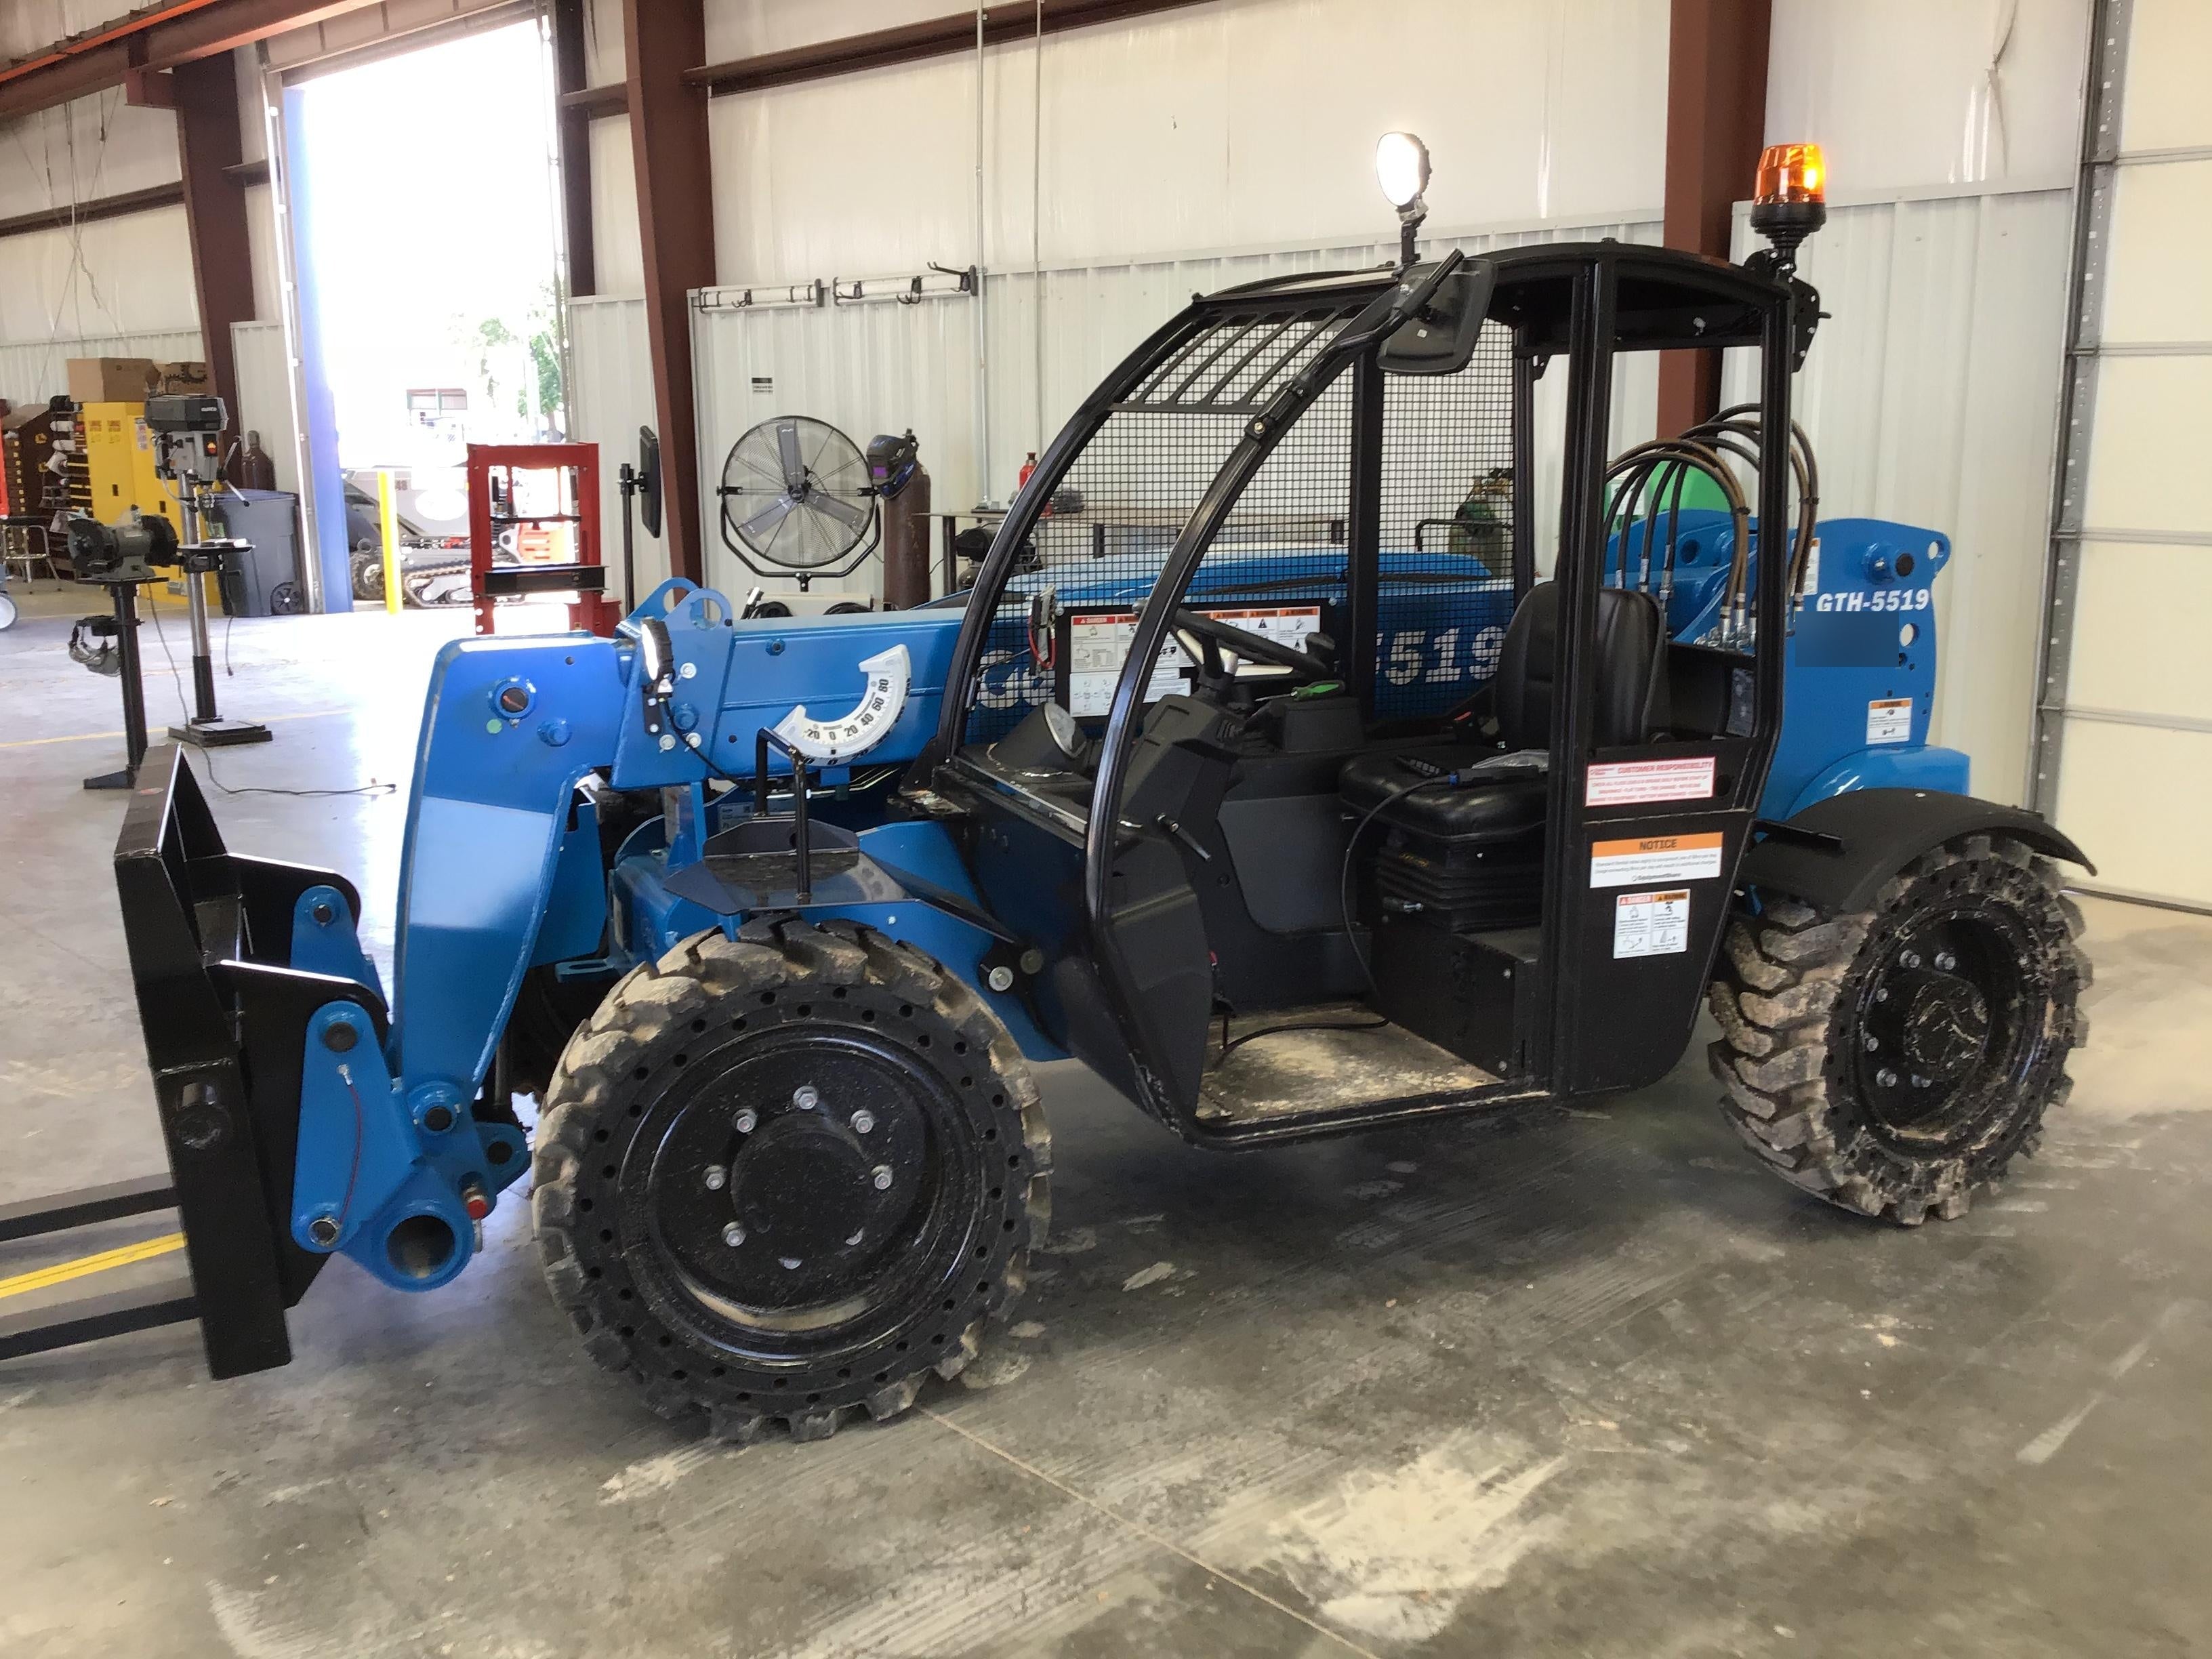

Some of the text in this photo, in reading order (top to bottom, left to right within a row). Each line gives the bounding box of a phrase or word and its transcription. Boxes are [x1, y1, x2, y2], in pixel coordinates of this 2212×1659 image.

[1816, 588, 1929, 613] GTH-5519
[1375, 626, 1507, 685] 519
[829, 731, 837, 741] 0
[844, 724, 859, 737] 20
[860, 713, 874, 726] 40
[872, 697, 884, 712] 60
[878, 678, 889, 693] 80
[1639, 839, 1679, 851] NOTICE
